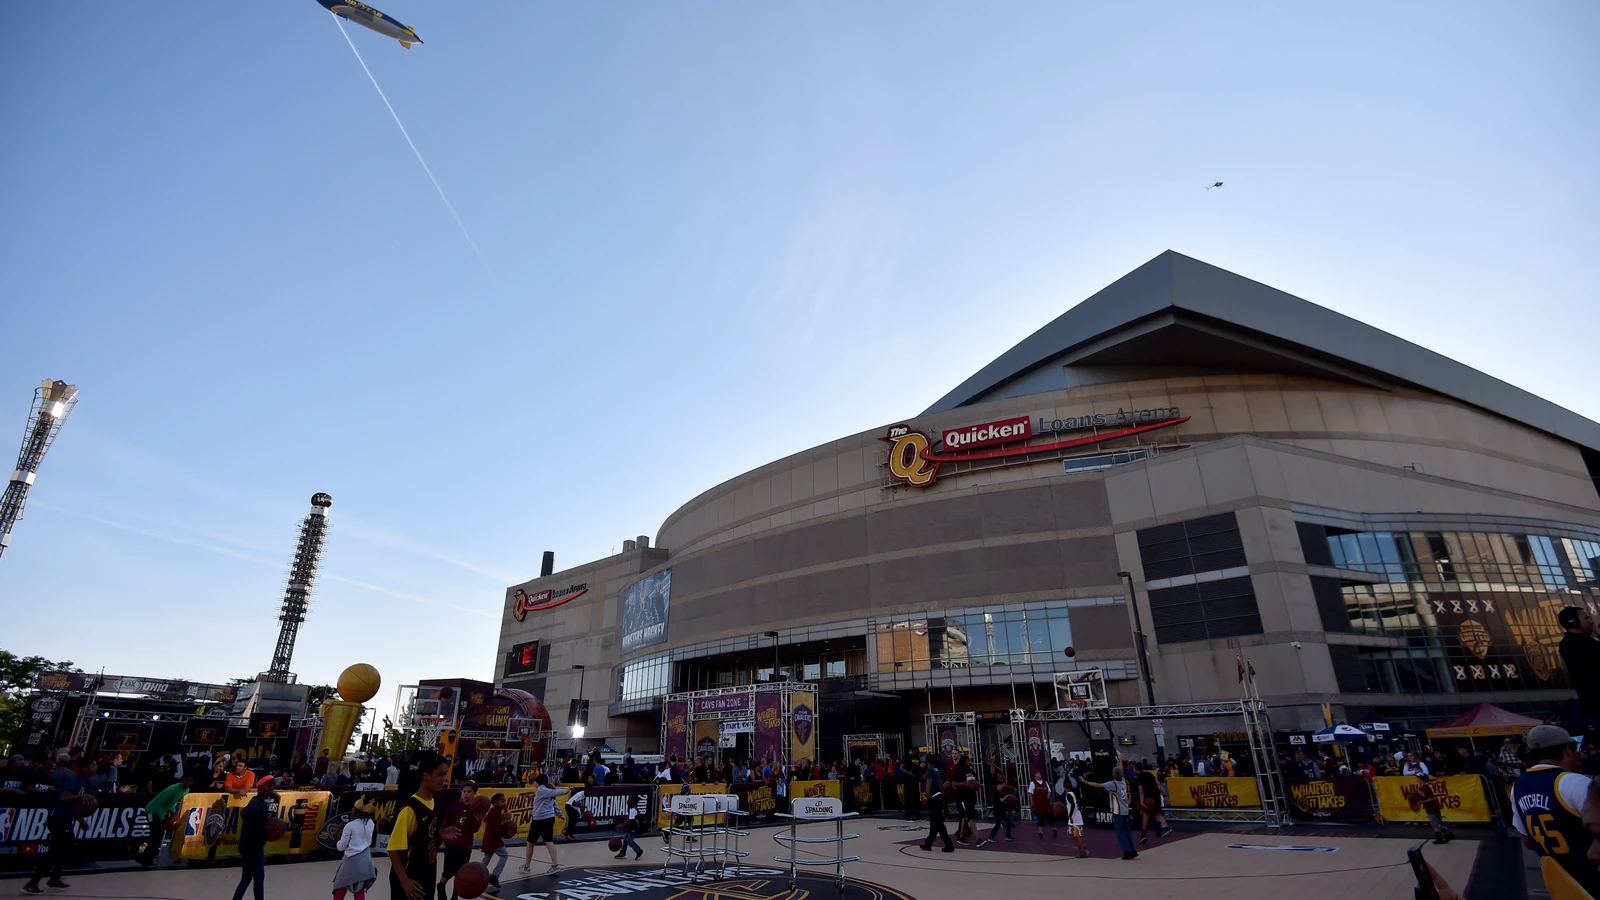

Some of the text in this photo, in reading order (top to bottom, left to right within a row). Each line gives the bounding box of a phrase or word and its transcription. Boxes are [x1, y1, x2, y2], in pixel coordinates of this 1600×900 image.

[890, 426, 908, 439] The
[946, 405, 1181, 447] Quicken Loans Arena
[889, 431, 937, 486] Q
[142, 682, 169, 692] OHIO
[701, 698, 741, 709] CAVS FAN ZONE
[32, 712, 52, 720] OHIO
[1190, 781, 1229, 799] WHATEVER
[1291, 780, 1335, 800] WHATEVER
[585, 796, 606, 818] NBA
[637, 794, 648, 815] 2018
[1213, 795, 1238, 808] TAKES
[1317, 796, 1346, 810] TAKES
[1517, 793, 1551, 813] MITCHELL
[303, 804, 319, 831] 2018
[1525, 813, 1571, 855] 45
